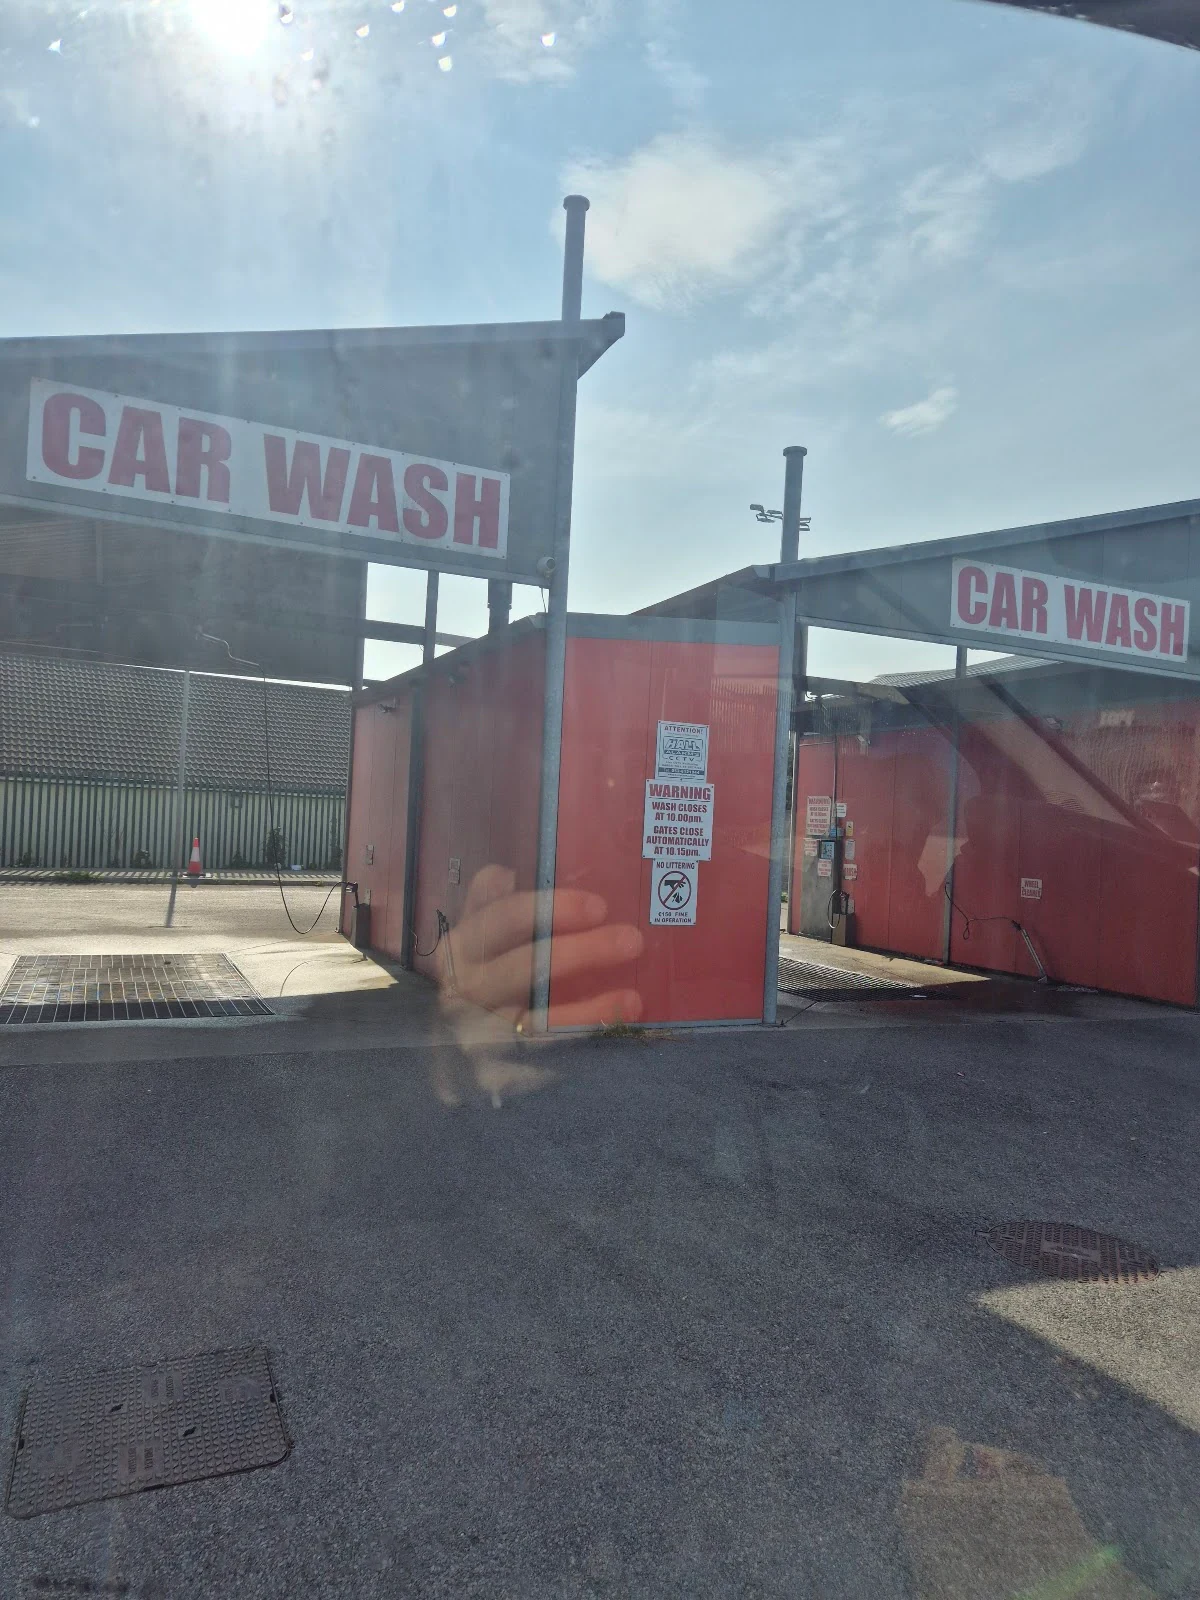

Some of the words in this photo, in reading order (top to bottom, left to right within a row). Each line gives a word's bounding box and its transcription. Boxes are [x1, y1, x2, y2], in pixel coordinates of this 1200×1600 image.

[41, 393, 232, 504] CAR
[263, 433, 501, 549] WASH
[958, 566, 1048, 634] CAR
[1064, 584, 1185, 656] WASH
[664, 725, 703, 735] ATTENTION!
[649, 783, 711, 801] WARNING
[652, 801, 676, 812] WASH
[678, 803, 707, 813] CLOSES
[655, 812, 665, 821] AT
[653, 825, 678, 835] GATES
[679, 826, 704, 837] CLOSE
[646, 835, 710, 847] AUTOMATICALLY
[654, 846, 665, 855] AT
[656, 861, 665, 869] NO
[666, 861, 695, 870] LITTERING
